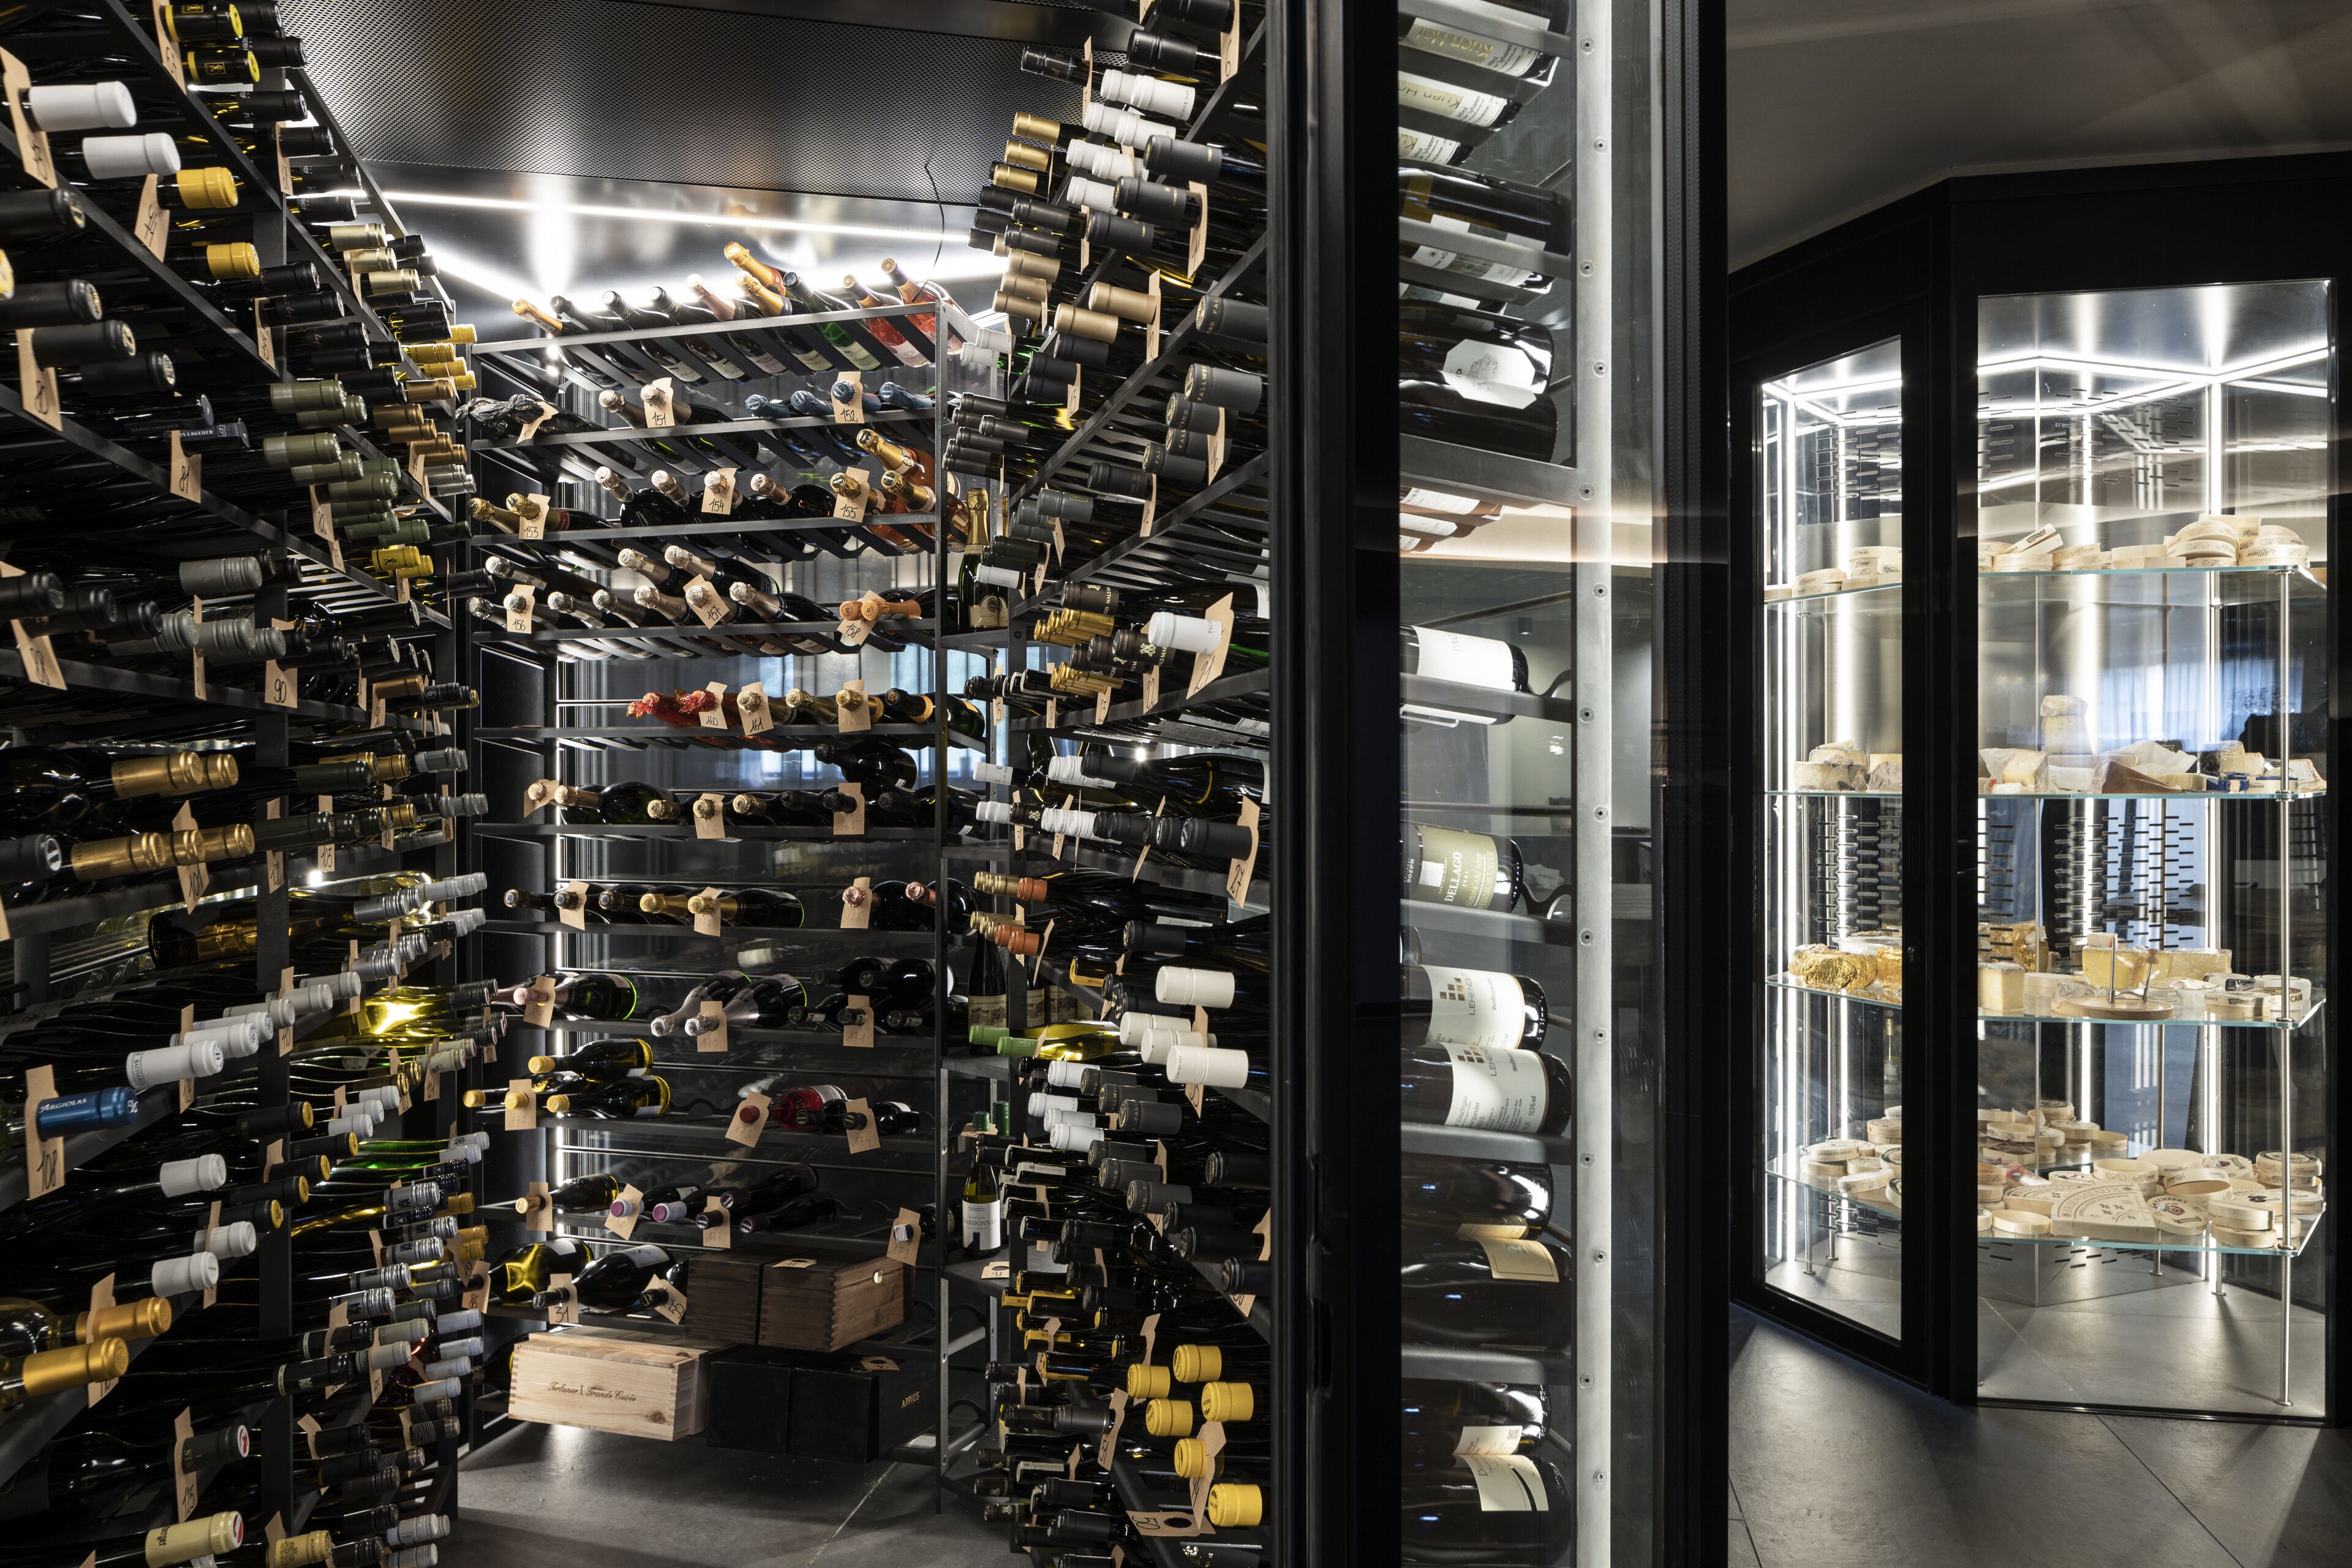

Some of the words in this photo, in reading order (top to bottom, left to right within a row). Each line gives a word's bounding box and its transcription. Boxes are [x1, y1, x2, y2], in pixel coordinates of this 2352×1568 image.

[1451, 37, 1494, 58] Kuen
[1423, 89, 1464, 110] Kuen
[1468, 95, 1481, 115] Sylvaner
[652, 412, 666, 426] 151
[840, 408, 859, 423] 152
[709, 499, 725, 513] 154
[840, 507, 859, 519] 155
[524, 525, 539, 539] 153
[2070, 546, 2095, 556] Affineur
[2247, 549, 2275, 557] Affineur
[707, 605, 723, 622] 157
[513, 619, 526, 632] 156
[845, 623, 862, 639] 158
[1194, 655, 1215, 693] 21
[274, 678, 287, 703] 90
[1147, 678, 1155, 708] 22
[1098, 699, 1106, 723] 23
[706, 715, 719, 727] 160
[750, 718, 763, 733] 161
[698, 824, 718, 836] 164
[835, 820, 858, 832] 165
[320, 845, 332, 868] 103
[1231, 865, 1245, 896] 27
[1444, 851, 1463, 902] DELLAGO
[188, 870, 202, 901] 101
[1461, 972, 1476, 1016] LEHENGUT
[701, 1038, 719, 1048] 170
[846, 1033, 866, 1043] 171
[1455, 1096, 1468, 1123] Vinschgau
[37, 1150, 57, 1192] 108
[2133, 1173, 2156, 1182] Affineur
[2082, 1186, 2119, 1199] MEAUX
[890, 1246, 910, 1259] 178
[554, 1306, 570, 1324] 31
[548, 1381, 578, 1394] Terlaner
[579, 1385, 584, 1395] I
[586, 1386, 613, 1399] Grande
[615, 1390, 637, 1402] Cuvée
[902, 1391, 920, 1408] APPIUS
[183, 1485, 195, 1520] 125
[1133, 1516, 1160, 1530] 50
